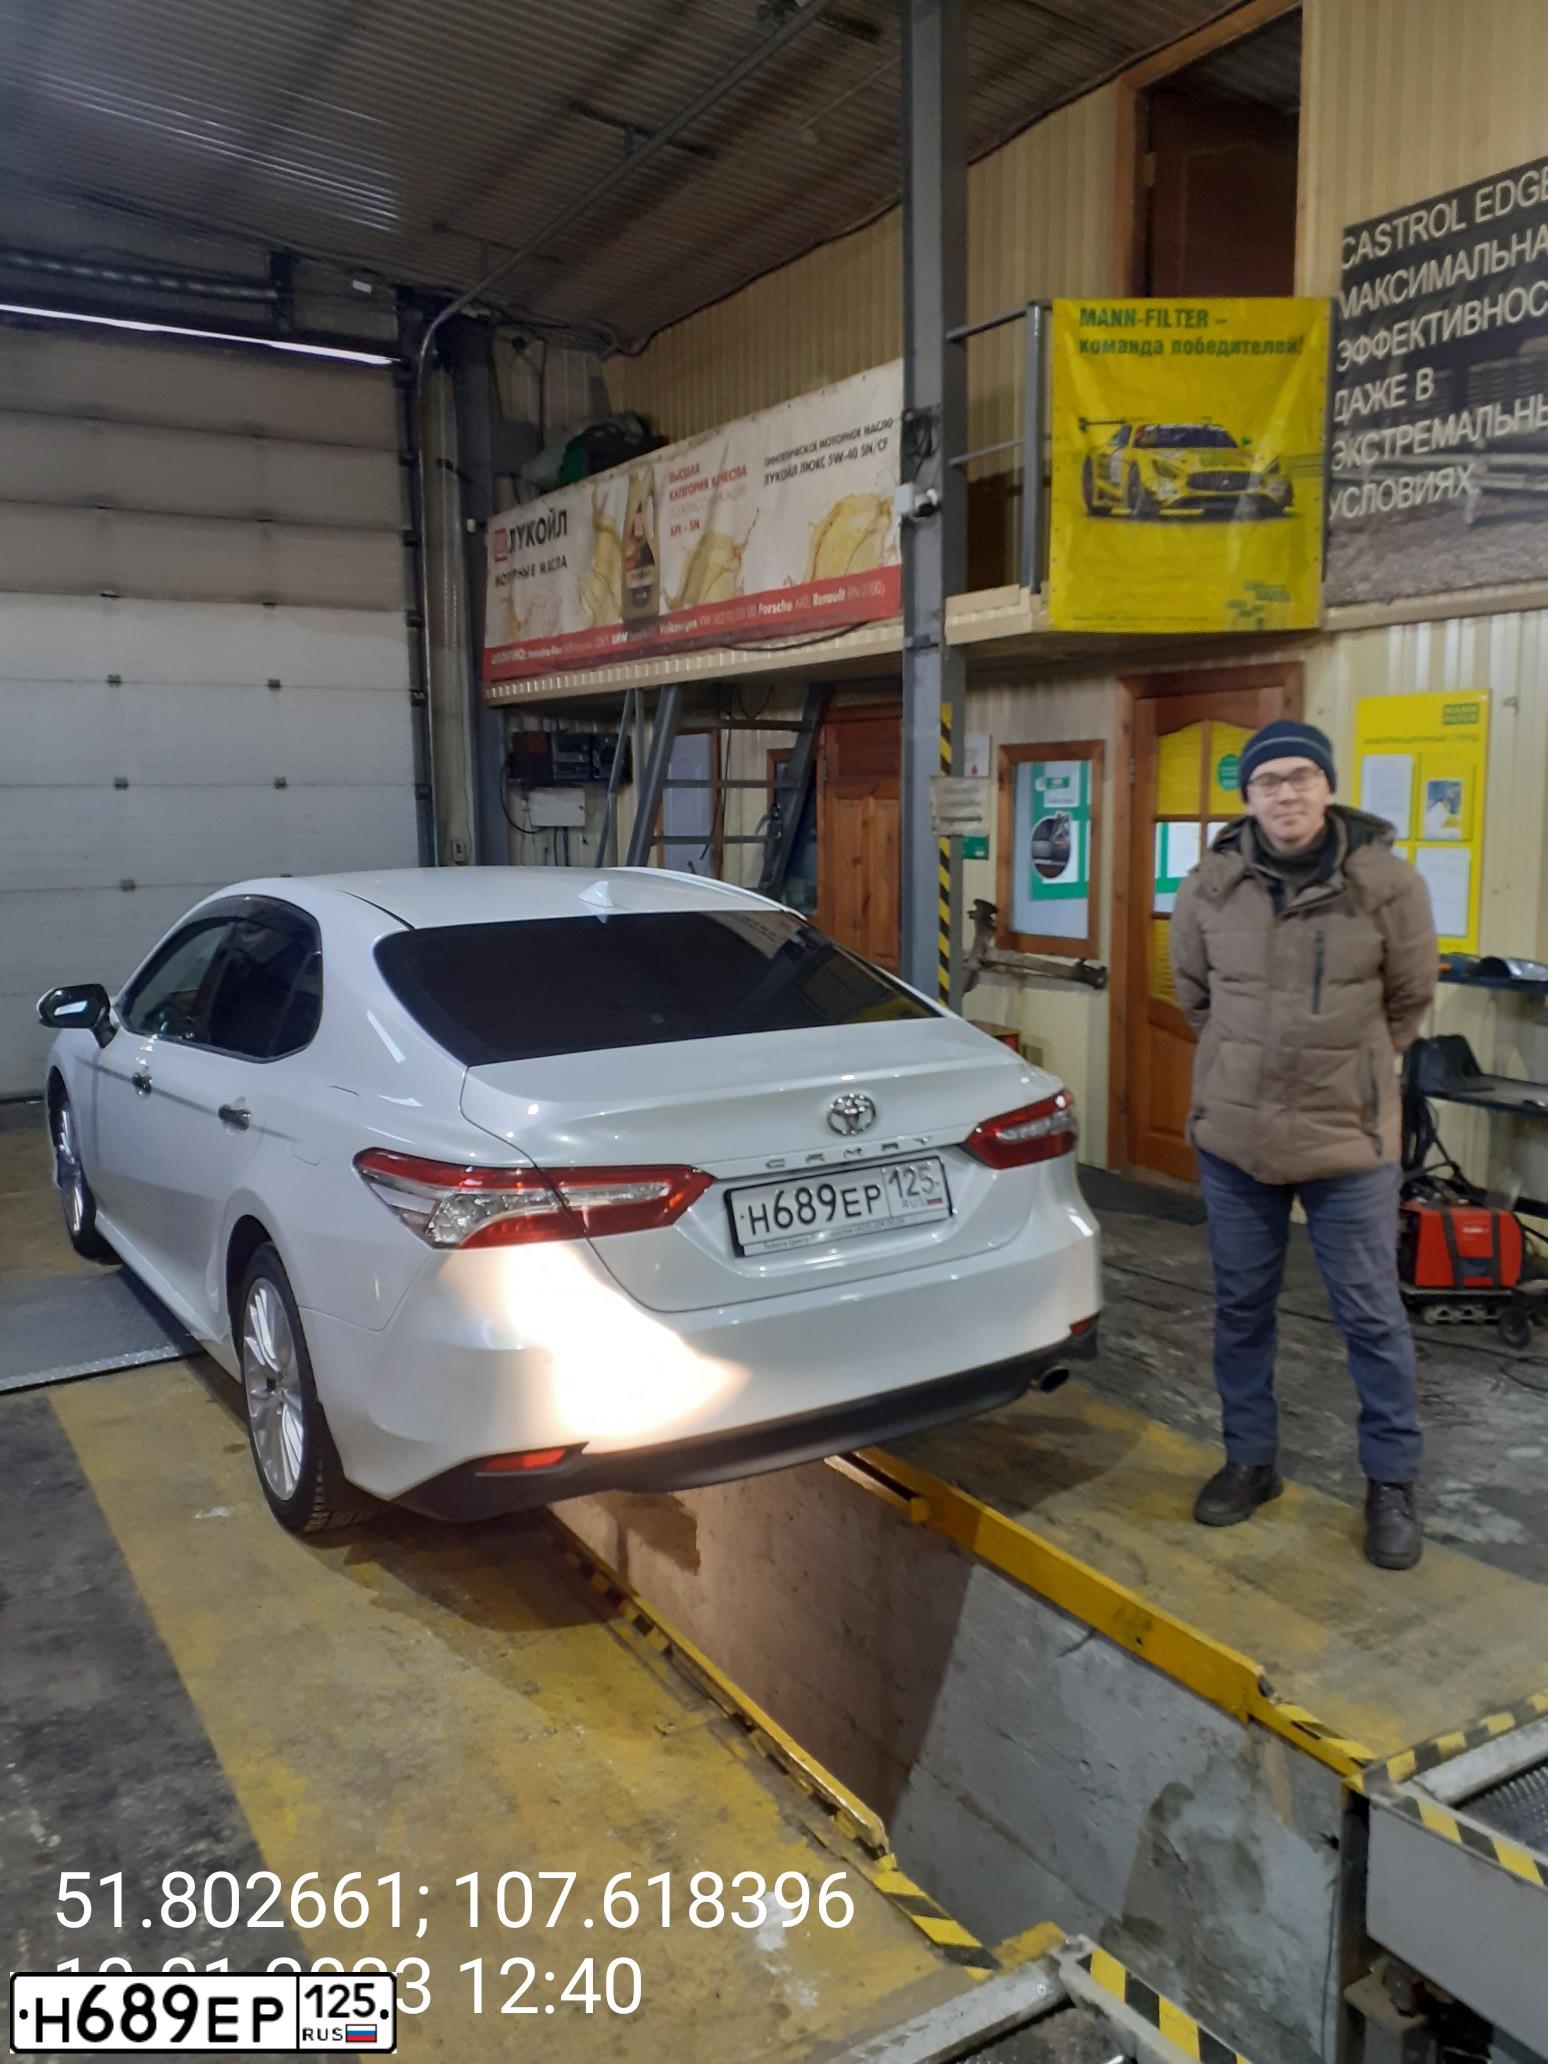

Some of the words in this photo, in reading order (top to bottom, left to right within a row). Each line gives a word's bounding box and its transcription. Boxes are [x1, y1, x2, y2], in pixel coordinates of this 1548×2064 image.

[1341, 198, 1467, 270] CASTROL
[1079, 307, 1208, 328] MANN-FILTER
[1079, 338, 1165, 357] команда
[1334, 373, 1408, 426] ДАЖЕ
[1415, 367, 1435, 401] В
[1328, 463, 1474, 522] УСЛОВИЯХ
[508, 507, 568, 554] ЛУКОЙЛ
[748, 1183, 881, 1236] Н689ЕР
[888, 1162, 936, 1199] 125
